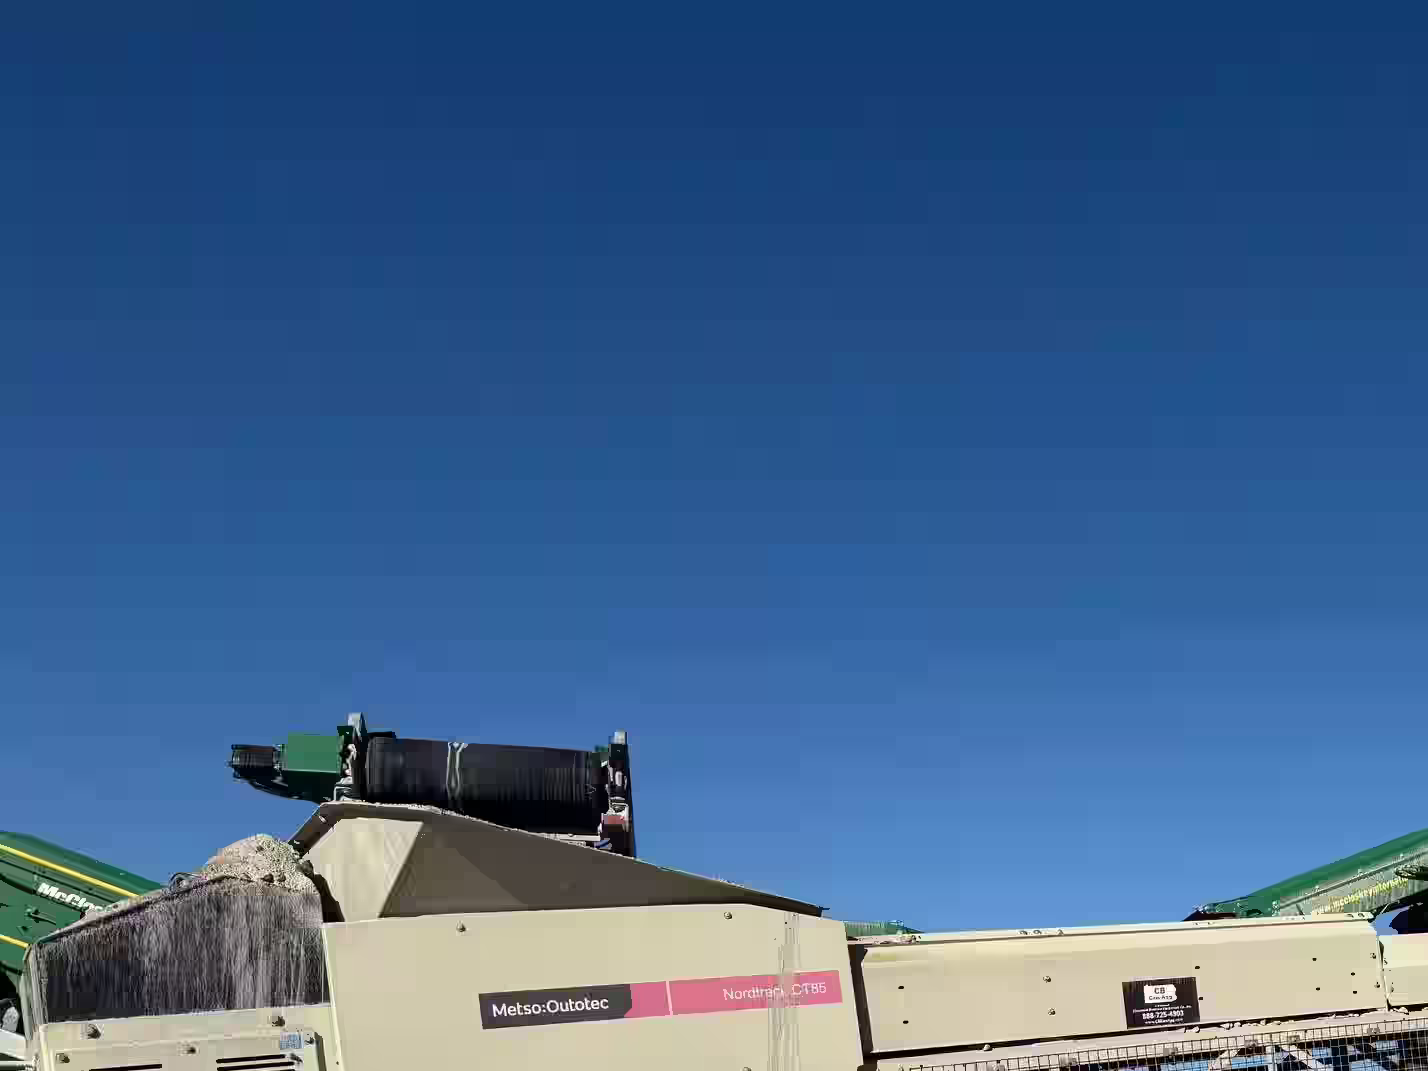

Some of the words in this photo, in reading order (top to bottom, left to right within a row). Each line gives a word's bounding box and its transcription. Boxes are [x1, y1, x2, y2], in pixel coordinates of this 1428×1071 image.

[723, 983, 784, 1001] Nordtrak
[1154, 987, 1166, 995] CB
[492, 997, 609, 1017] Metso:Outotec
